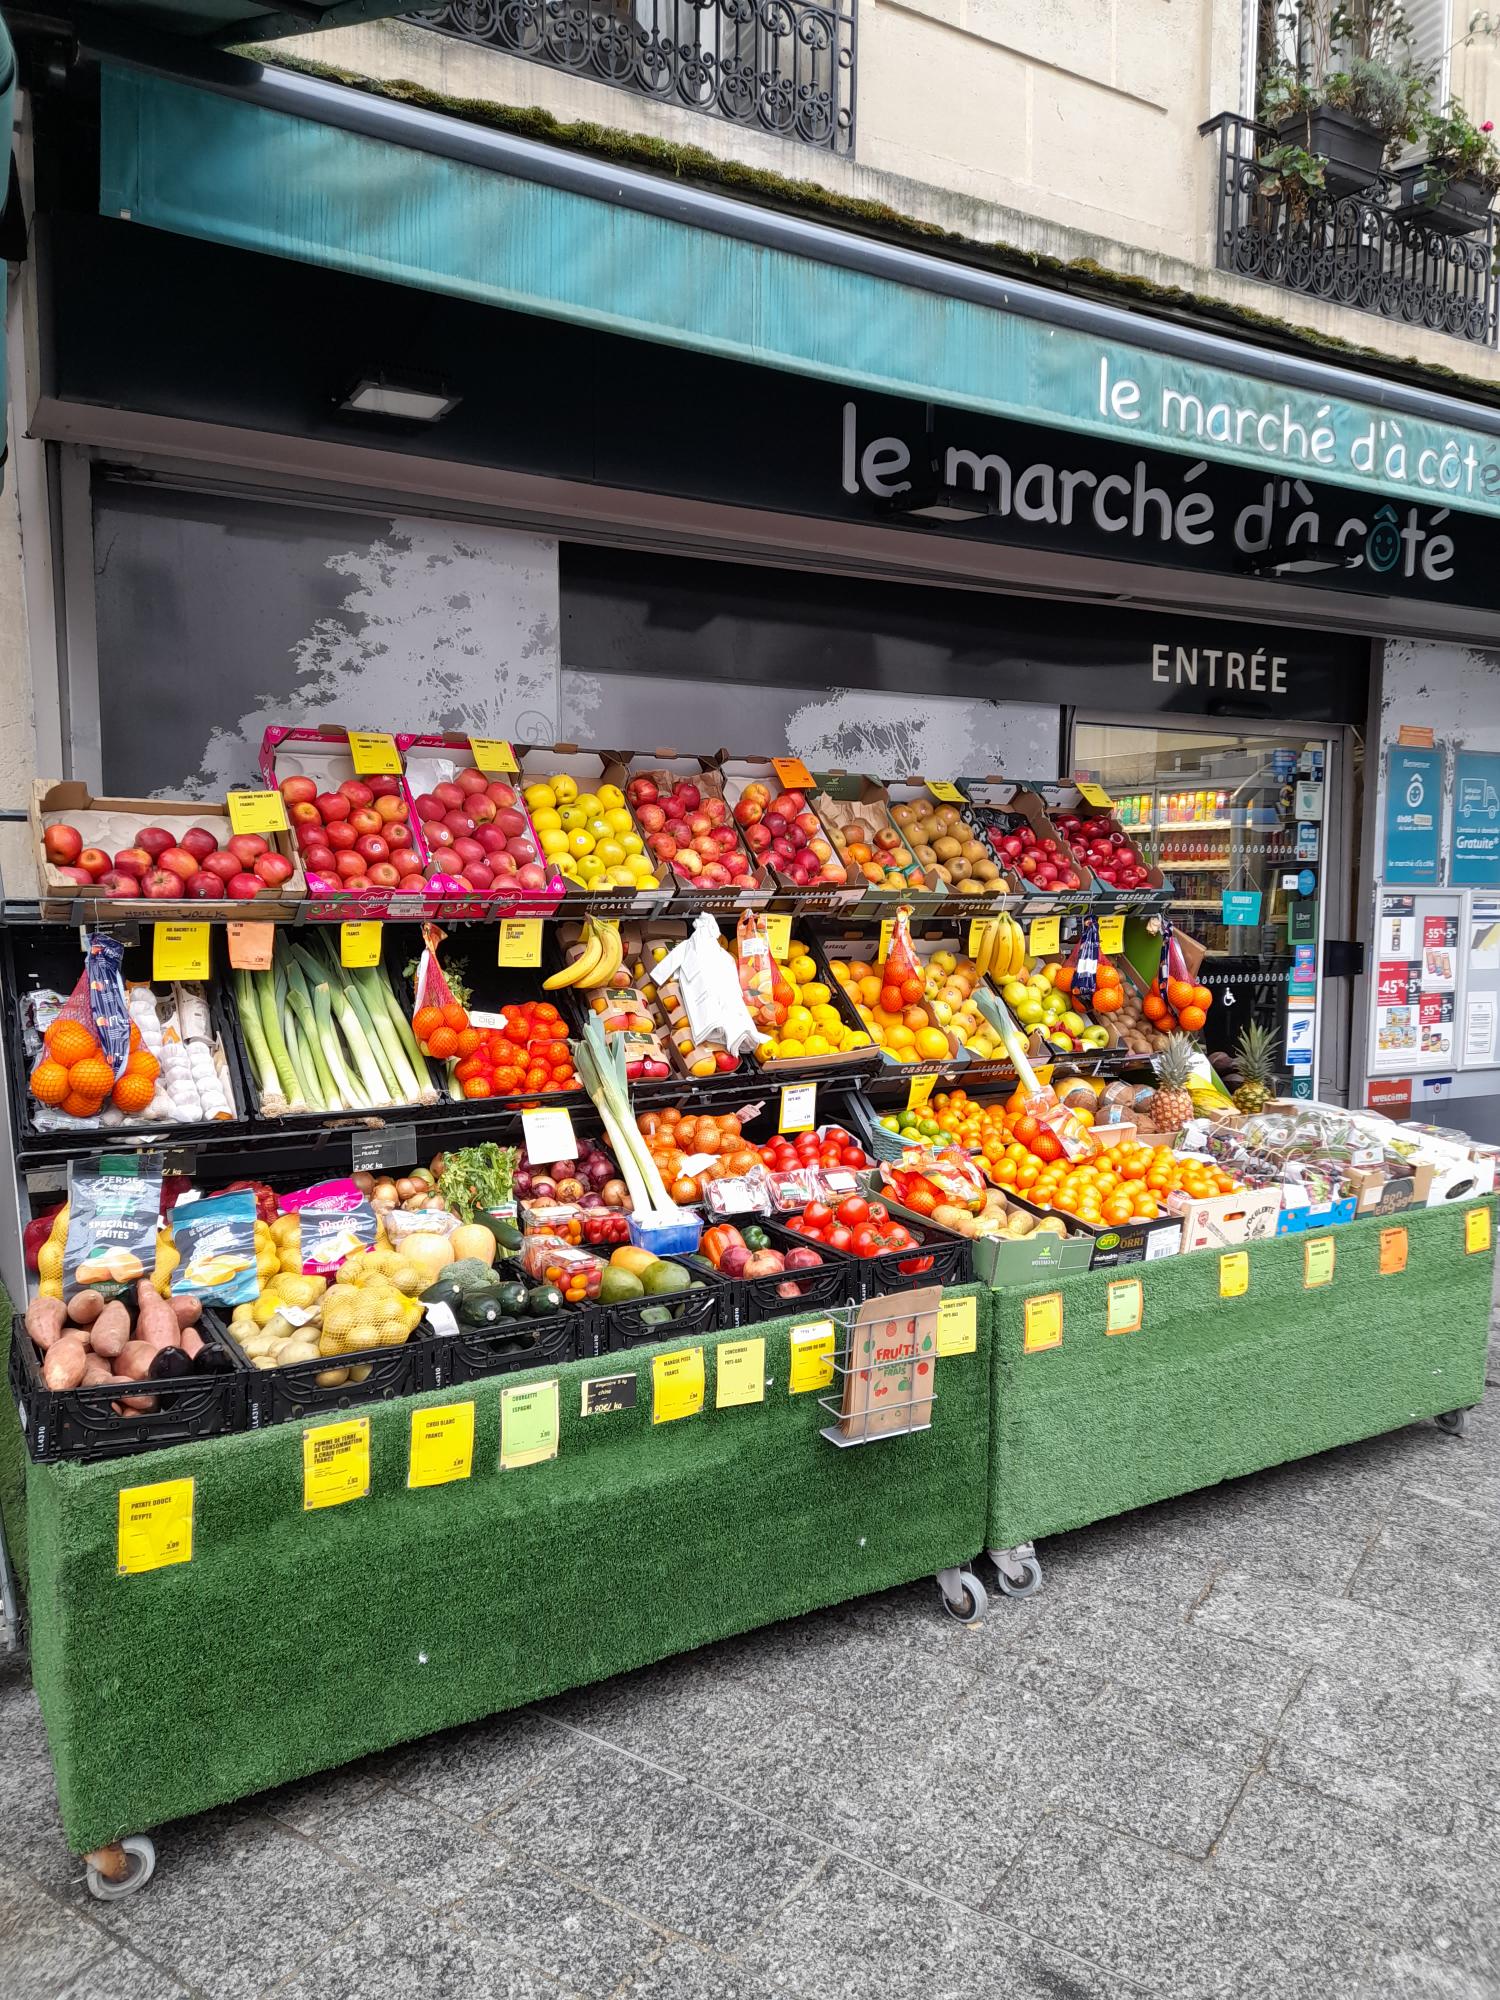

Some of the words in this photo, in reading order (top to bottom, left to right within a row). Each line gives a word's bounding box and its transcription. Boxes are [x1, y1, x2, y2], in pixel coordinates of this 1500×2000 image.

[1099, 355, 1142, 421] le
[1162, 387, 1336, 465] marché
[1349, 420, 1408, 482] d'à
[841, 401, 915, 498] le
[945, 446, 1215, 546] marché
[1152, 643, 1289, 694] ENTRÉE
[1116, 892, 1159, 901] castang
[900, 1063, 951, 1074] castang
[876, 1343, 919, 1360] FRUITS
[131, 1501, 152, 1510] PATATE
[152, 1497, 172, 1507] DOUCE
